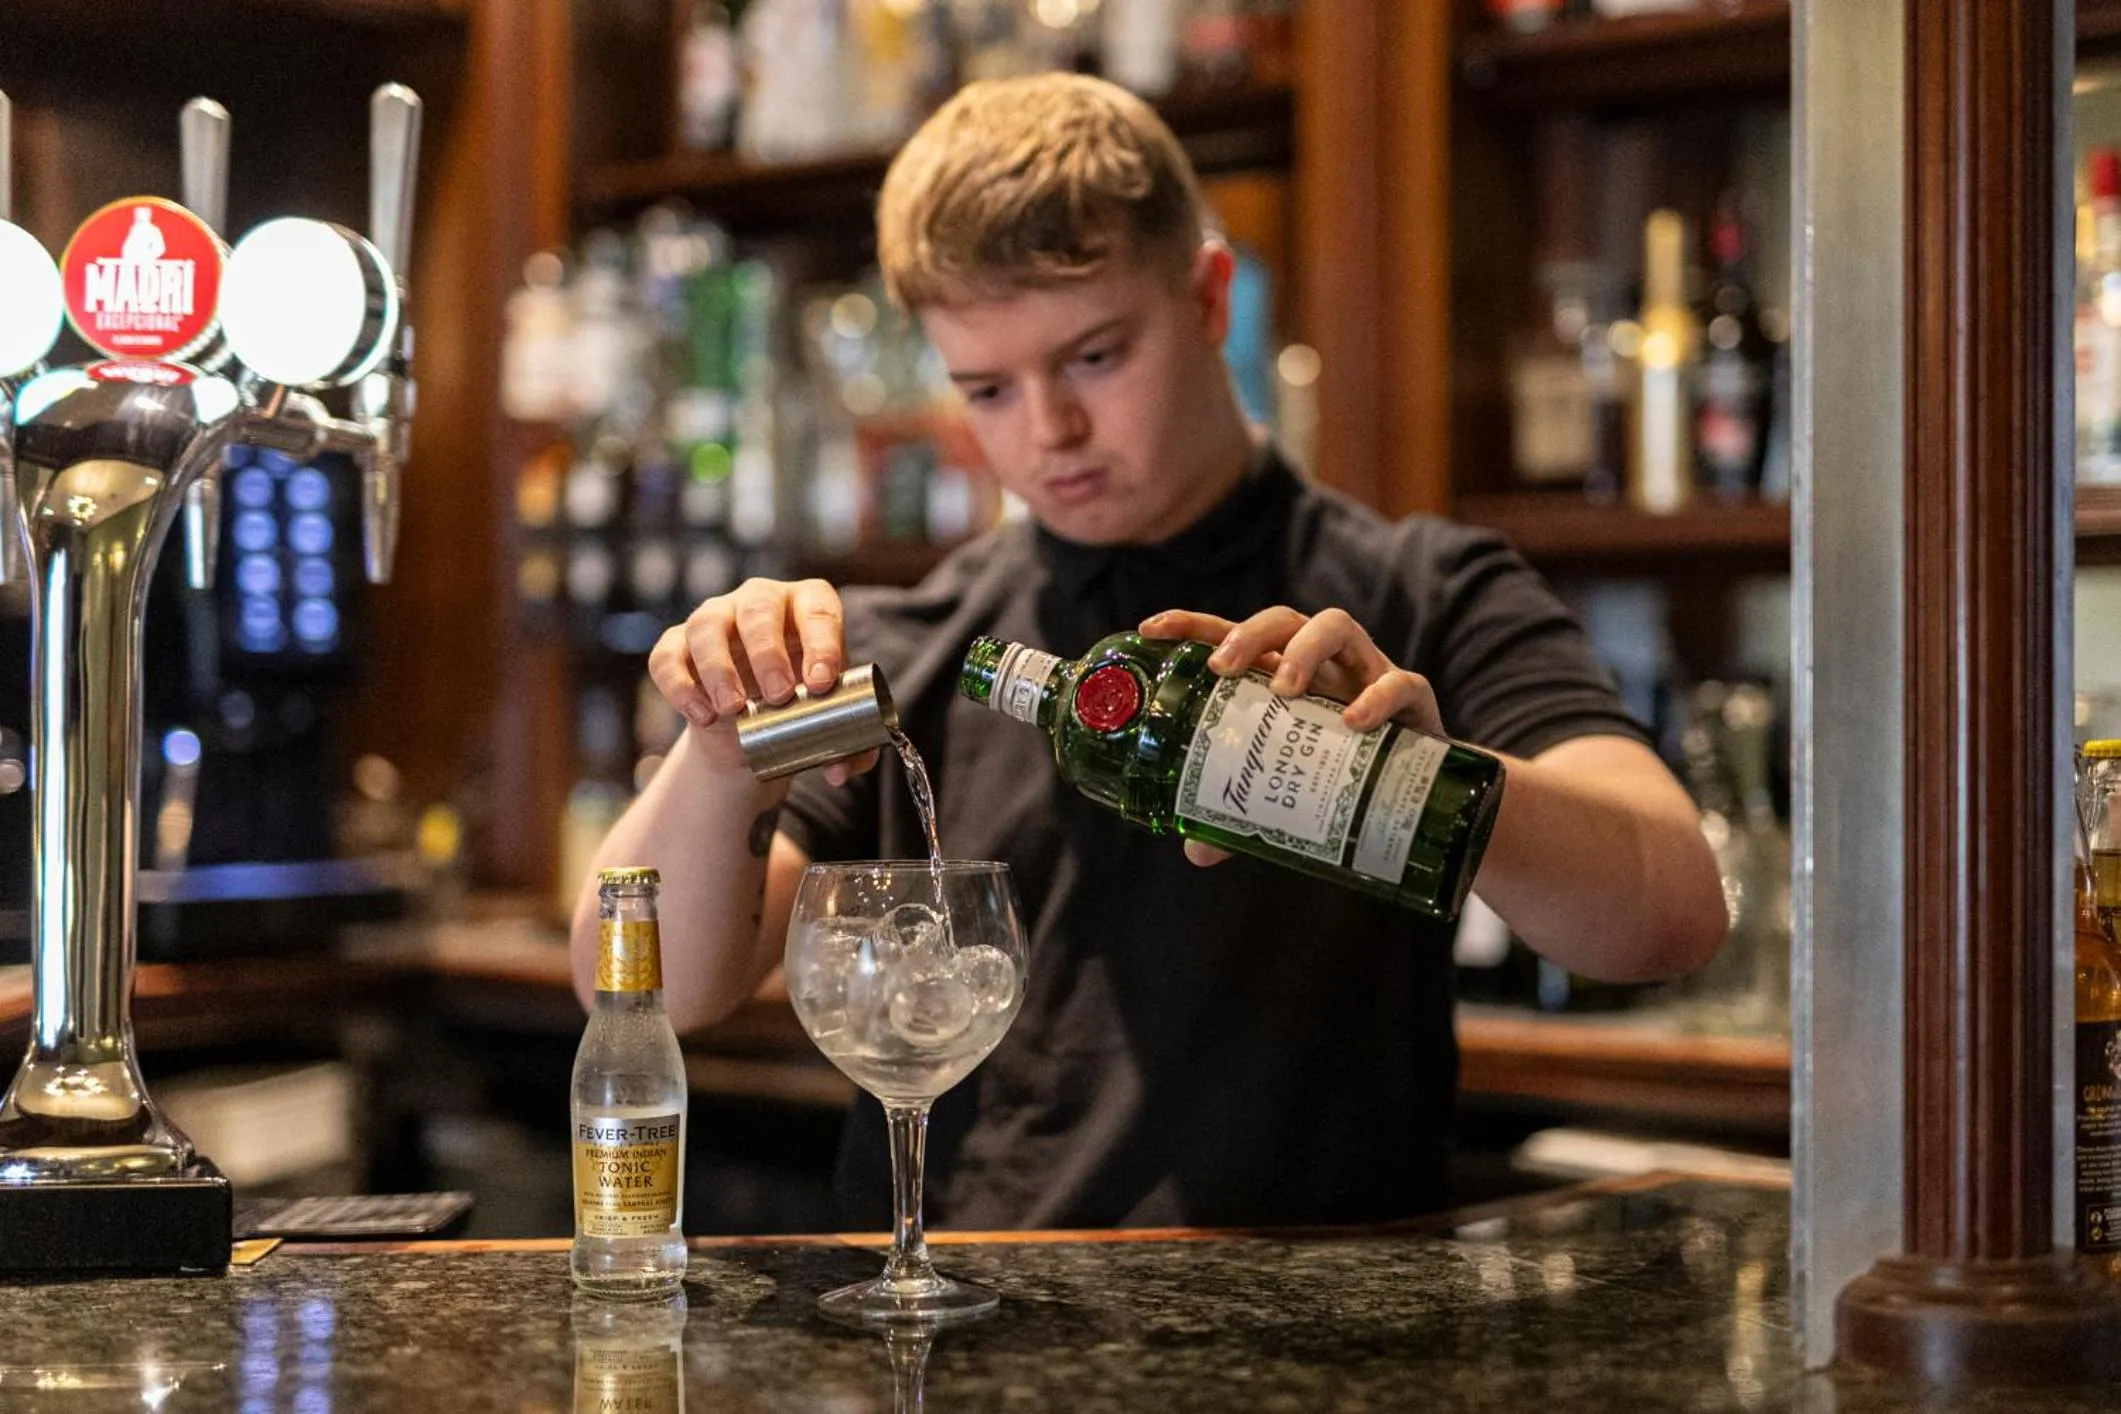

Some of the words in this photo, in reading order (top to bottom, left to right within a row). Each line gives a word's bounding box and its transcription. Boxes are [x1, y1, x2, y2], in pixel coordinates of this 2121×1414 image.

[1223, 694, 1290, 815] Tanqueray
[1264, 717, 1307, 803] LONDON
[1281, 765, 1305, 809] DRY
[1300, 723, 1323, 757] GIN
[579, 1124, 676, 1140] FEVER-TREE
[598, 1176, 654, 1188] WATER
[600, 1161, 651, 1173] TONIC
